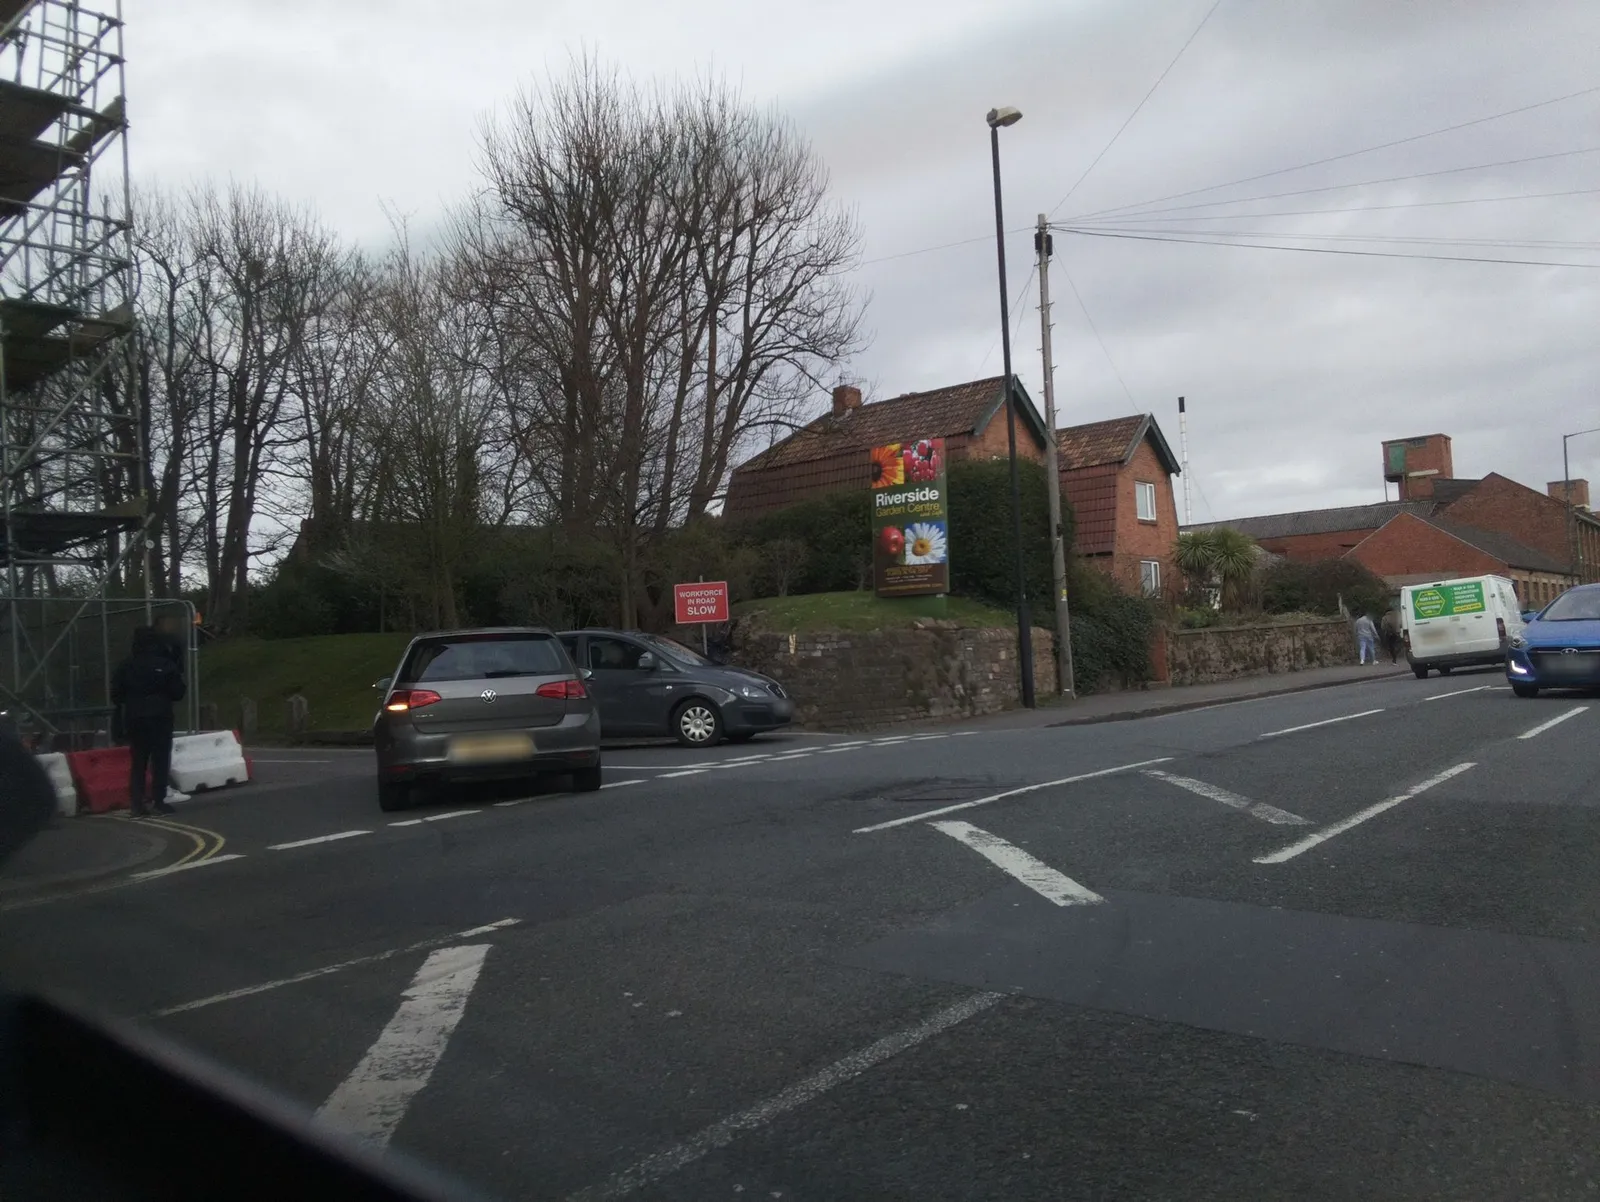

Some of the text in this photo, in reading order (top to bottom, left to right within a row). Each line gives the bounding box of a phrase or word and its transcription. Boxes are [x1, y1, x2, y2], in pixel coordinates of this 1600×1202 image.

[876, 487, 939, 507] Riverside
[876, 502, 940, 517] Garden Centre
[679, 589, 723, 598] WORKFORCE
[687, 605, 716, 615] SLOW
